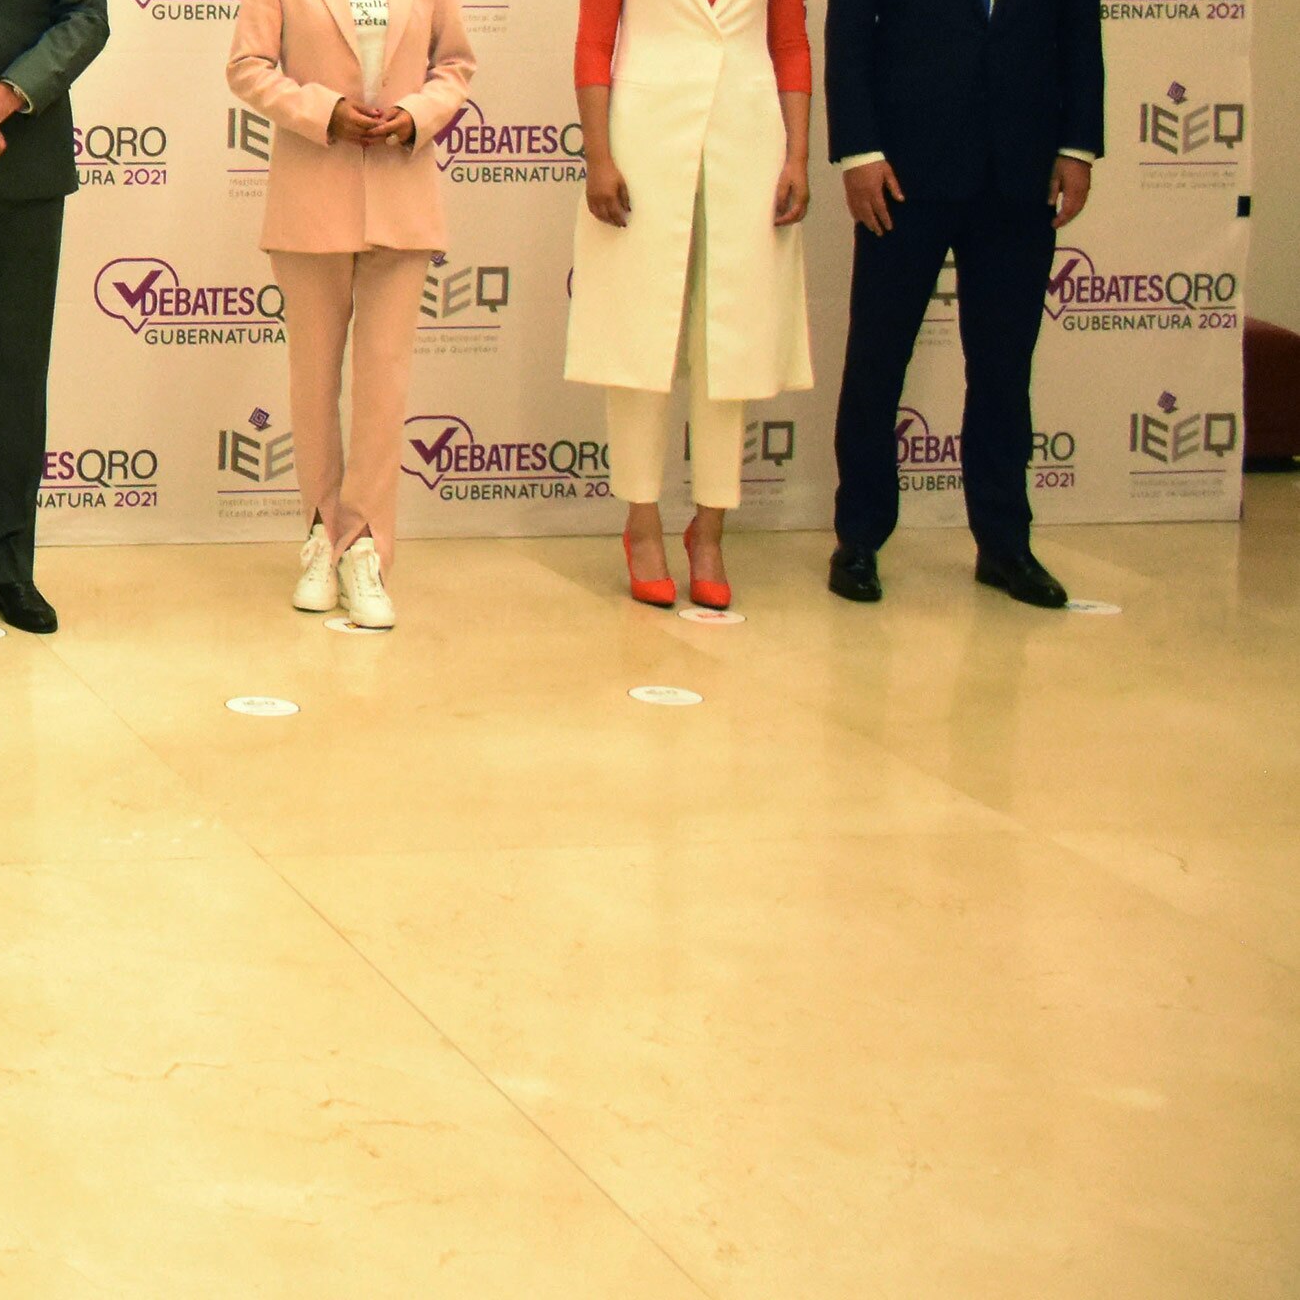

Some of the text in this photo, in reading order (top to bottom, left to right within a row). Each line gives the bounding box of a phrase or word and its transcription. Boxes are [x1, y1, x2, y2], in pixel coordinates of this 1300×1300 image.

[1139, 102, 1244, 156] IEEQ
[1062, 313, 1238, 332] GUBERNATURA 2021
[1129, 410, 1236, 465] IEEQ
